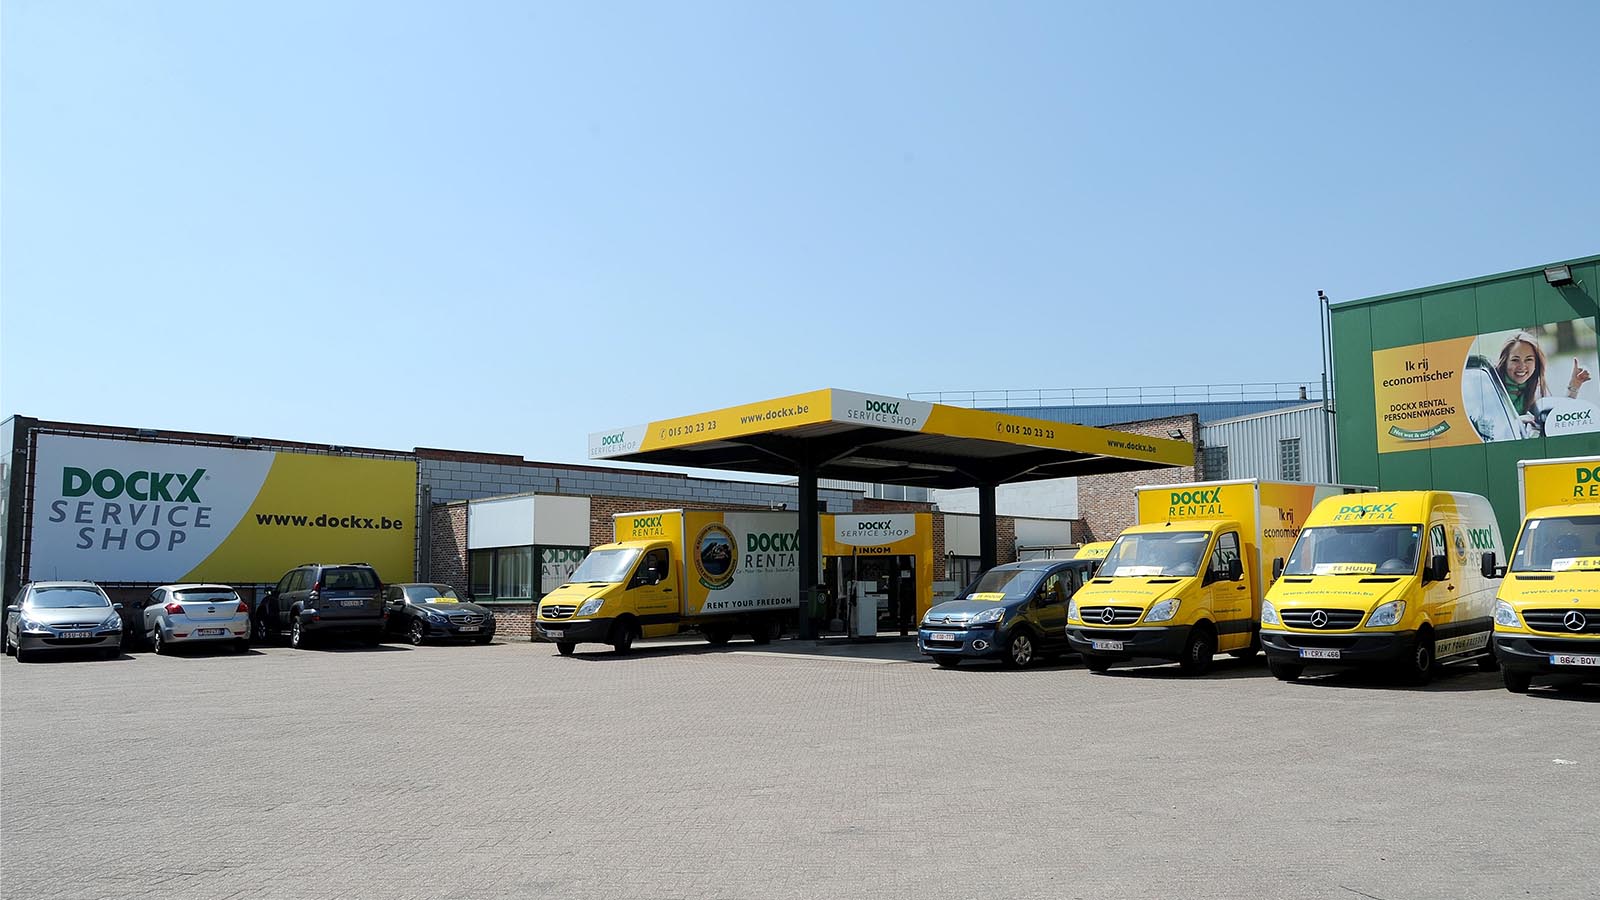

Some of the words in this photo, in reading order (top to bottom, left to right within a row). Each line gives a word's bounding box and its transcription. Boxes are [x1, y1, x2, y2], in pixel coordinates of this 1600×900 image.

[1405, 361, 1415, 371] Ik
[1417, 358, 1429, 371] rij
[1382, 370, 1454, 387] economischer
[866, 400, 900, 415] DOCKX
[1390, 402, 1417, 412] DOCKX
[1418, 398, 1447, 408] RENTAL
[740, 404, 809, 424] www.dockx.be
[847, 409, 887, 422] SERVICE
[893, 415, 917, 426] SHOP
[1384, 407, 1455, 421] PERSONENWAGENS
[1556, 409, 1591, 421] DOCKX
[668, 427, 681, 437] 015
[685, 425, 693, 434] 20
[696, 422, 704, 432] 23
[708, 420, 716, 430] 23
[1006, 424, 1019, 434] 015
[1023, 427, 1032, 436] 20
[1034, 429, 1043, 437] 23
[1046, 430, 1055, 439] 23
[1555, 420, 1594, 428] RENTAL
[602, 431, 624, 446] DOCKX
[1107, 438, 1157, 453] www.dockx.be
[591, 443, 616, 456] SERVICE
[618, 441, 636, 451] SHOP
[62, 466, 207, 503] DOCKX
[1170, 487, 1222, 506] DOCKX
[48, 500, 212, 528] SERVICE
[1169, 504, 1224, 516] RENTAL
[1278, 508, 1285, 520] Ik
[1339, 503, 1398, 514] DOCKX
[256, 513, 403, 530] www.dockx.be
[633, 515, 663, 528] DOCKX
[1332, 512, 1395, 521] RENTAL
[632, 527, 664, 537] RENTAL
[858, 519, 892, 530] DOCKX
[76, 527, 187, 551] SHOP
[747, 529, 800, 552] DOCKX
[1467, 524, 1495, 549] DOCKX
[745, 553, 800, 568] RENTA
[757, 597, 792, 606] FREEDOM
[1560, 656, 1597, 665] 864-BQV
